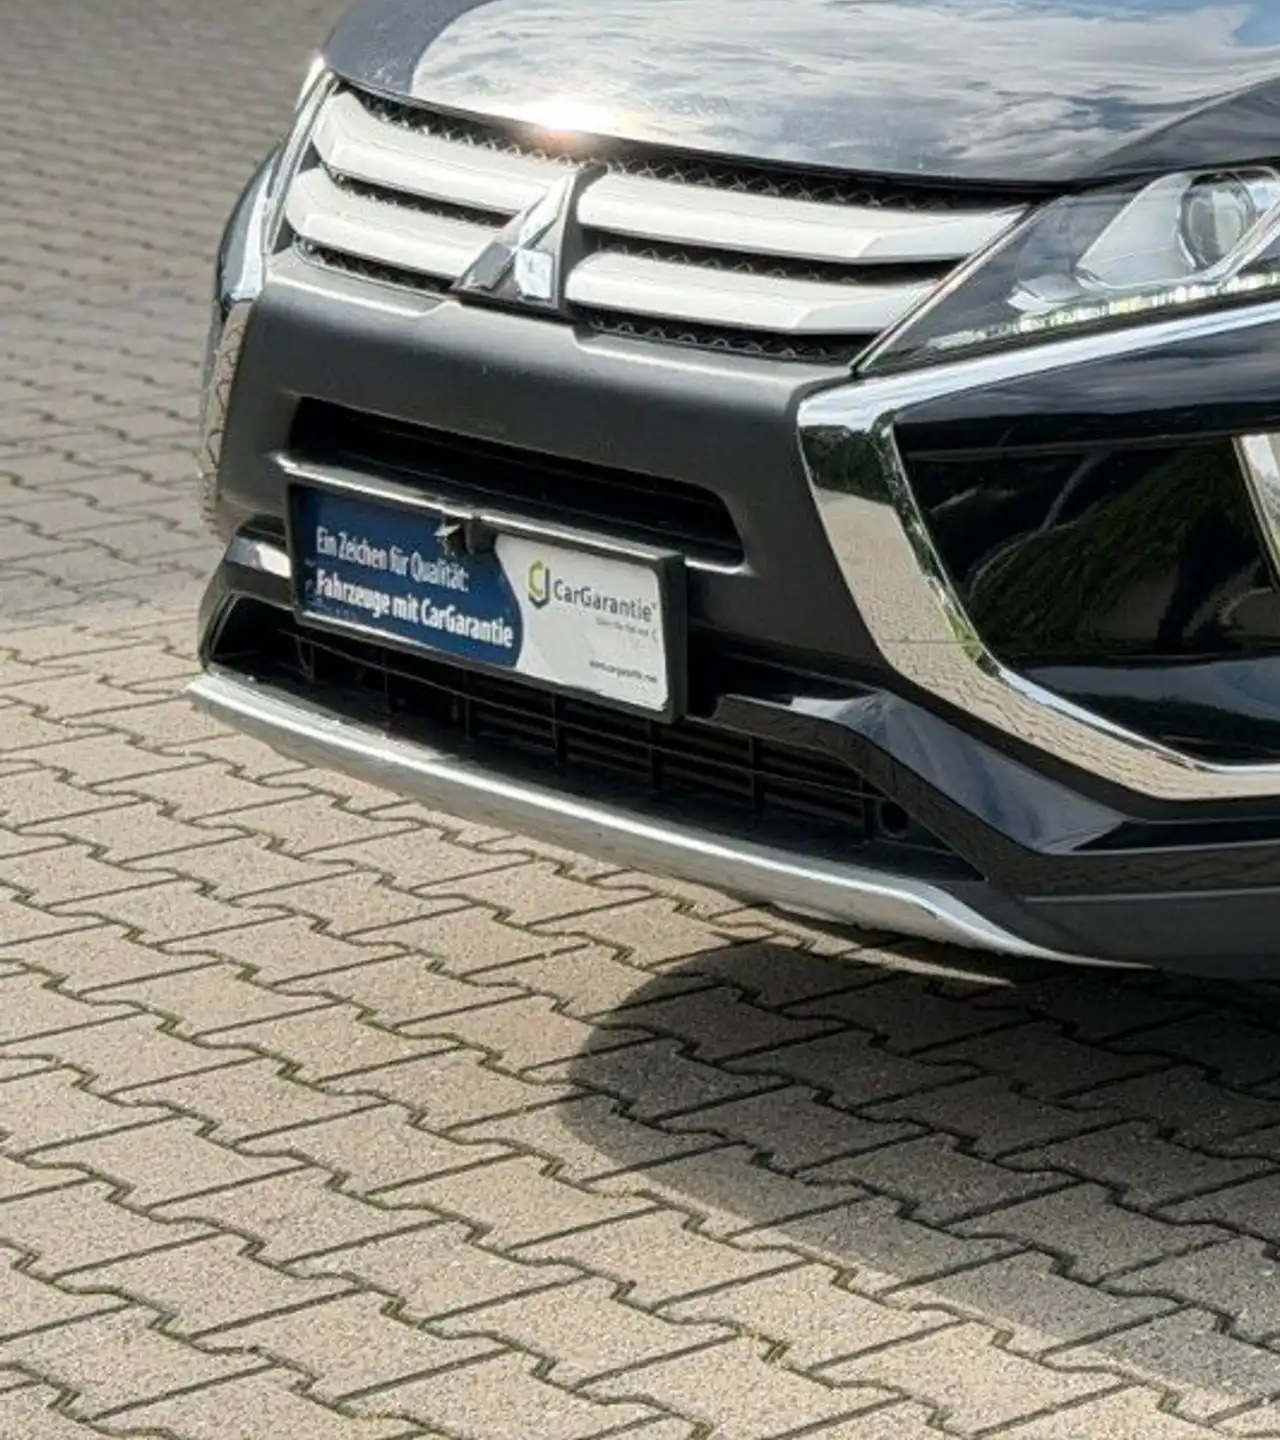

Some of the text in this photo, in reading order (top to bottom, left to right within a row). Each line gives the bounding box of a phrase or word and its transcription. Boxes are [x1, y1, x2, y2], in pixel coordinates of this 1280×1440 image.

[316, 525, 337, 558] Ein
[338, 531, 388, 570] Zeichen
[389, 544, 409, 577] für
[316, 568, 514, 648] Fahrzeuge mit CarGarantie
